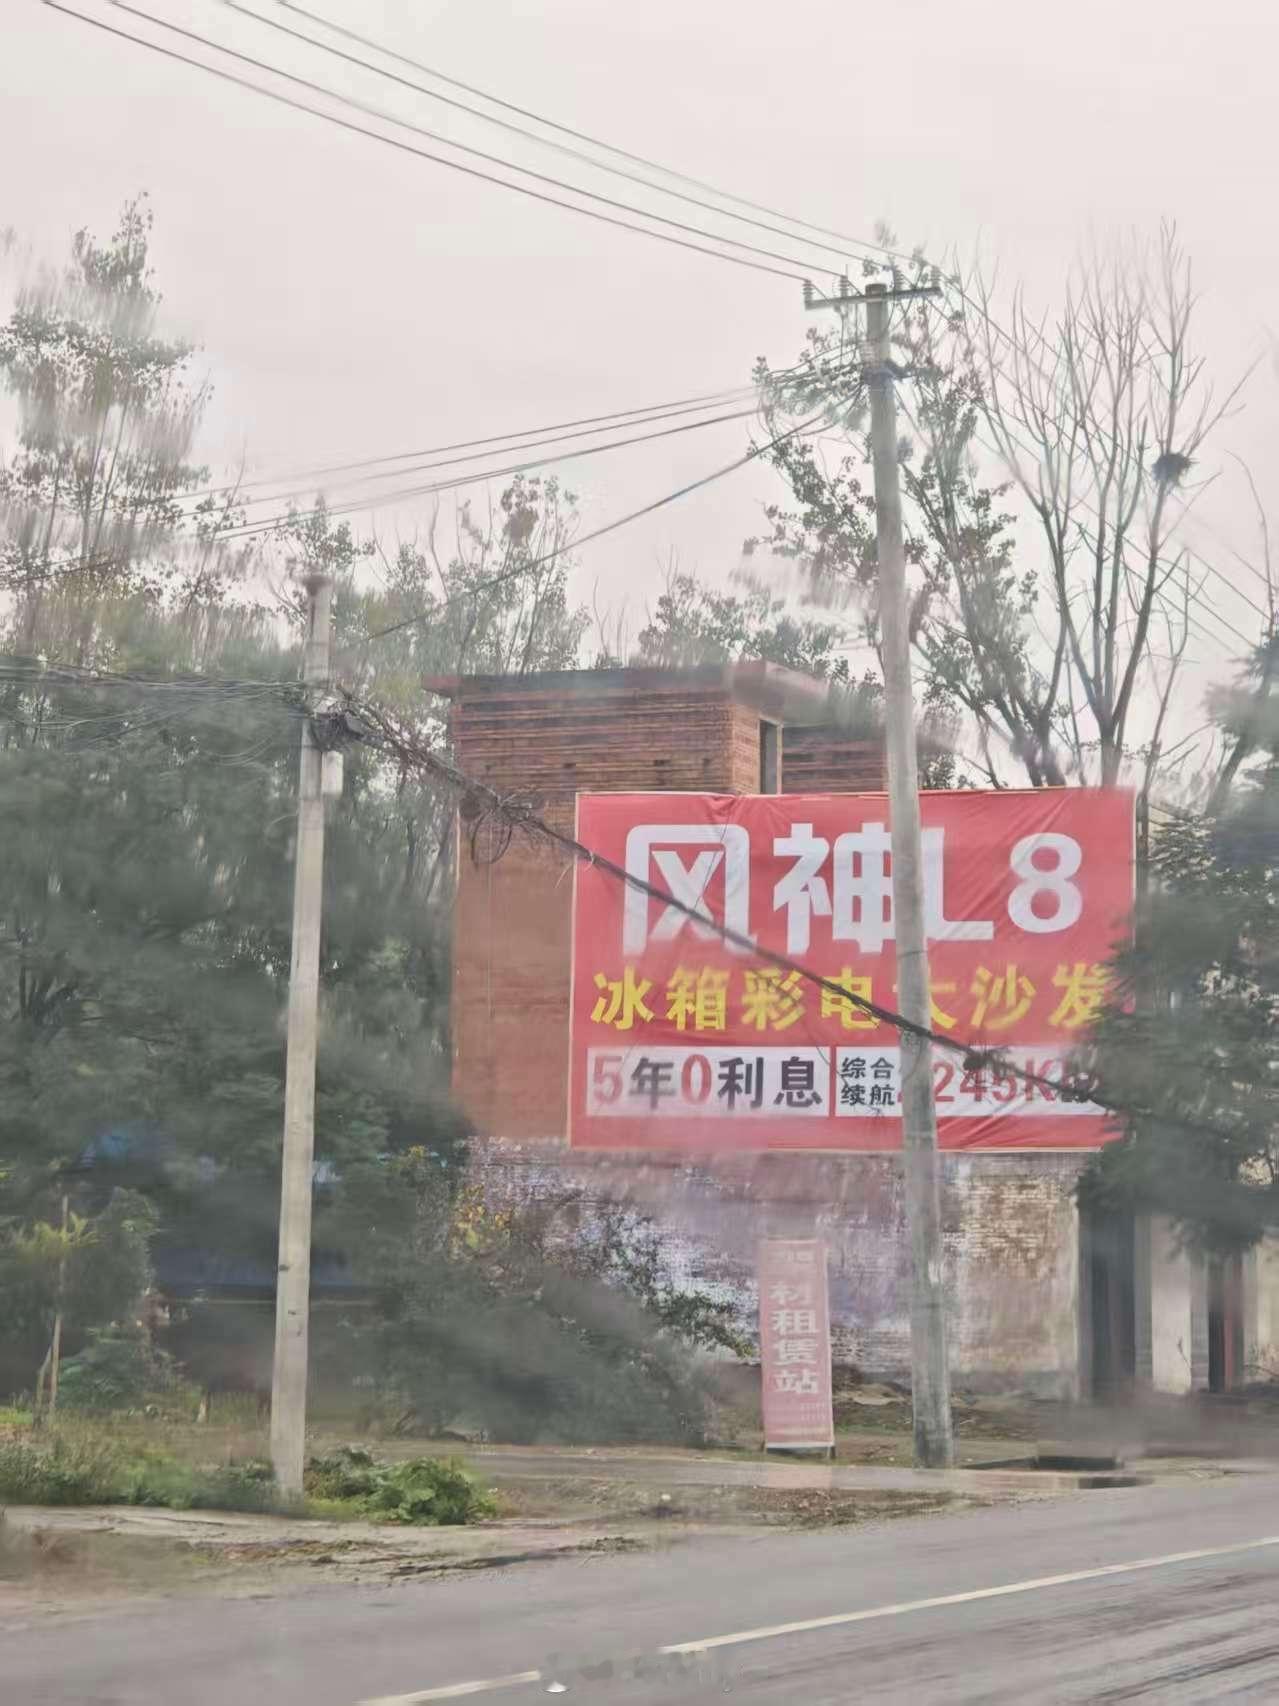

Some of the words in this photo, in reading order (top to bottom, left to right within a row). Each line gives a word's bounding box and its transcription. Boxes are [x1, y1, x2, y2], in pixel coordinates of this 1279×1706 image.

[623, 822, 1083, 955] 风神L8
[592, 1054, 824, 1112] 5年0利息
[840, 1057, 895, 1080] 综合
[841, 1083, 895, 1107] 续航
